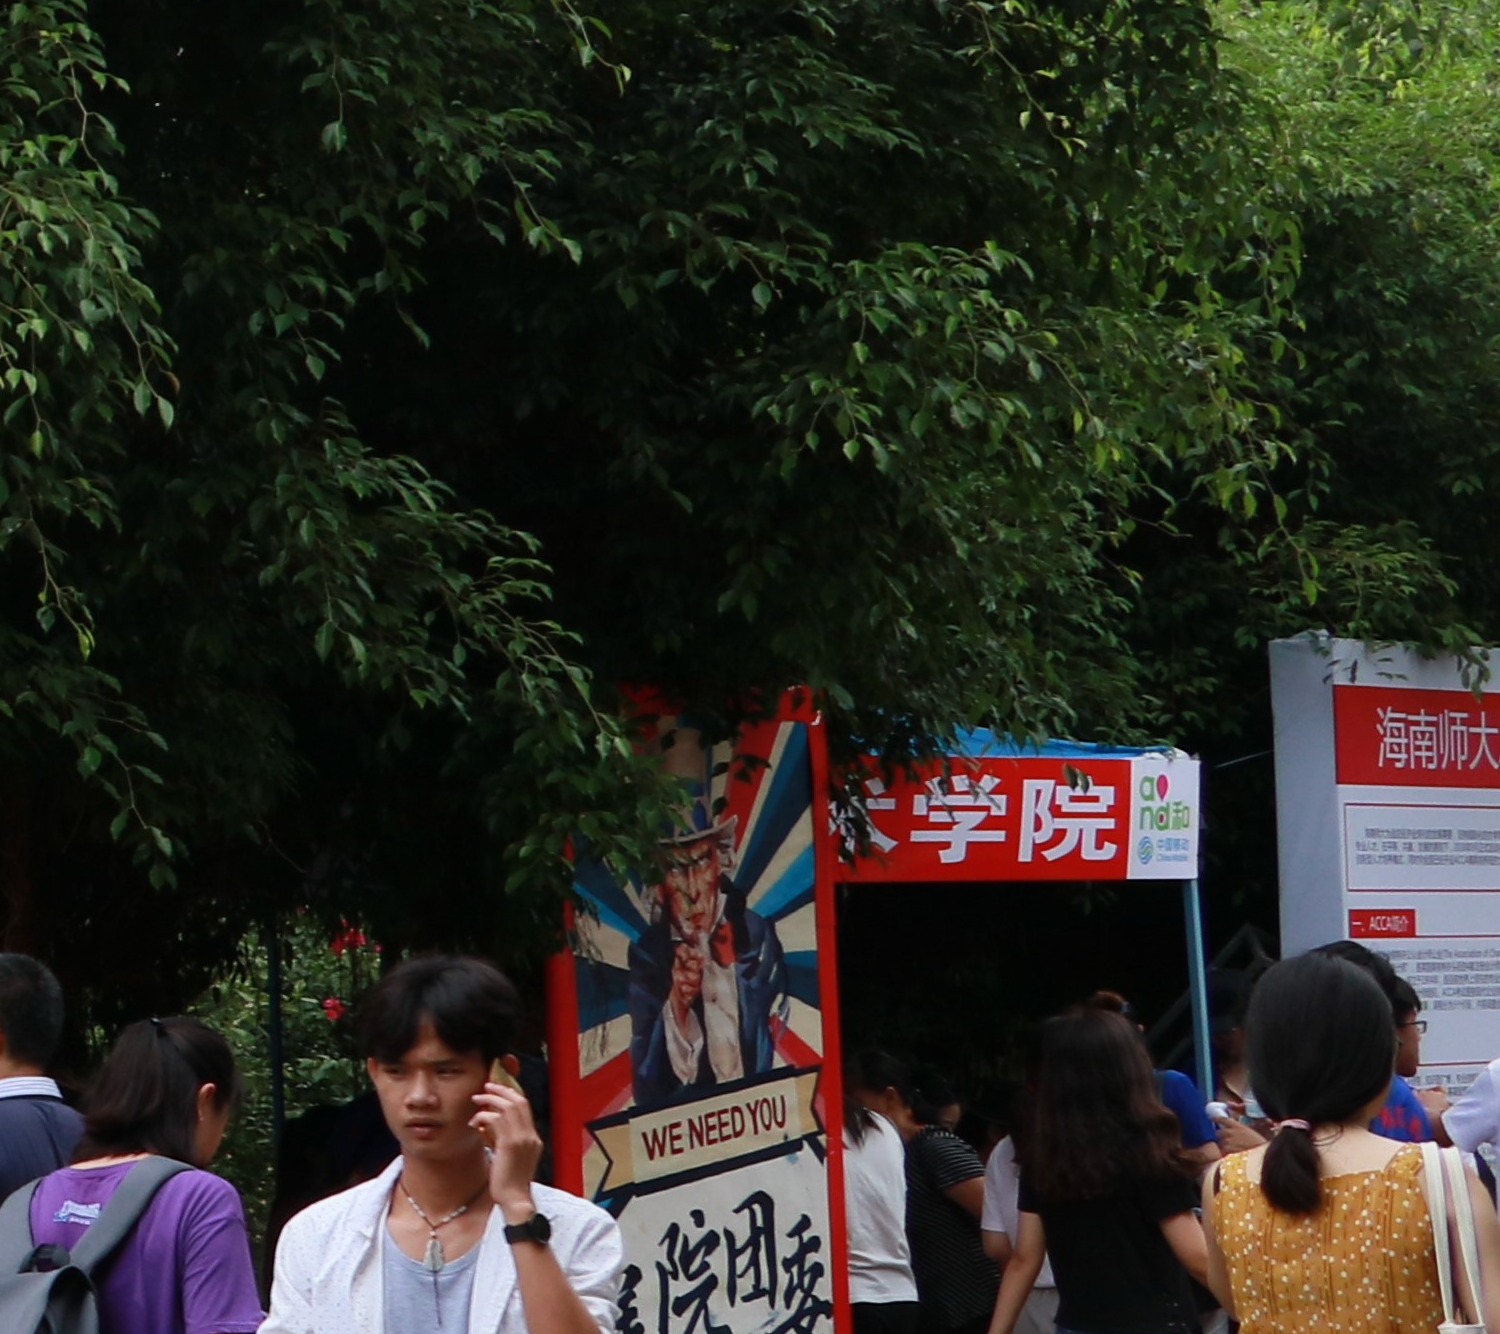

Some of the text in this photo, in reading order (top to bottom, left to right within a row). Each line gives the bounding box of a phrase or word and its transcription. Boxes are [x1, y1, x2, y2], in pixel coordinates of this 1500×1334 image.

[1376, 706, 1500, 770] 海南师大
[641, 1097, 786, 1161] WE NEED YOU
